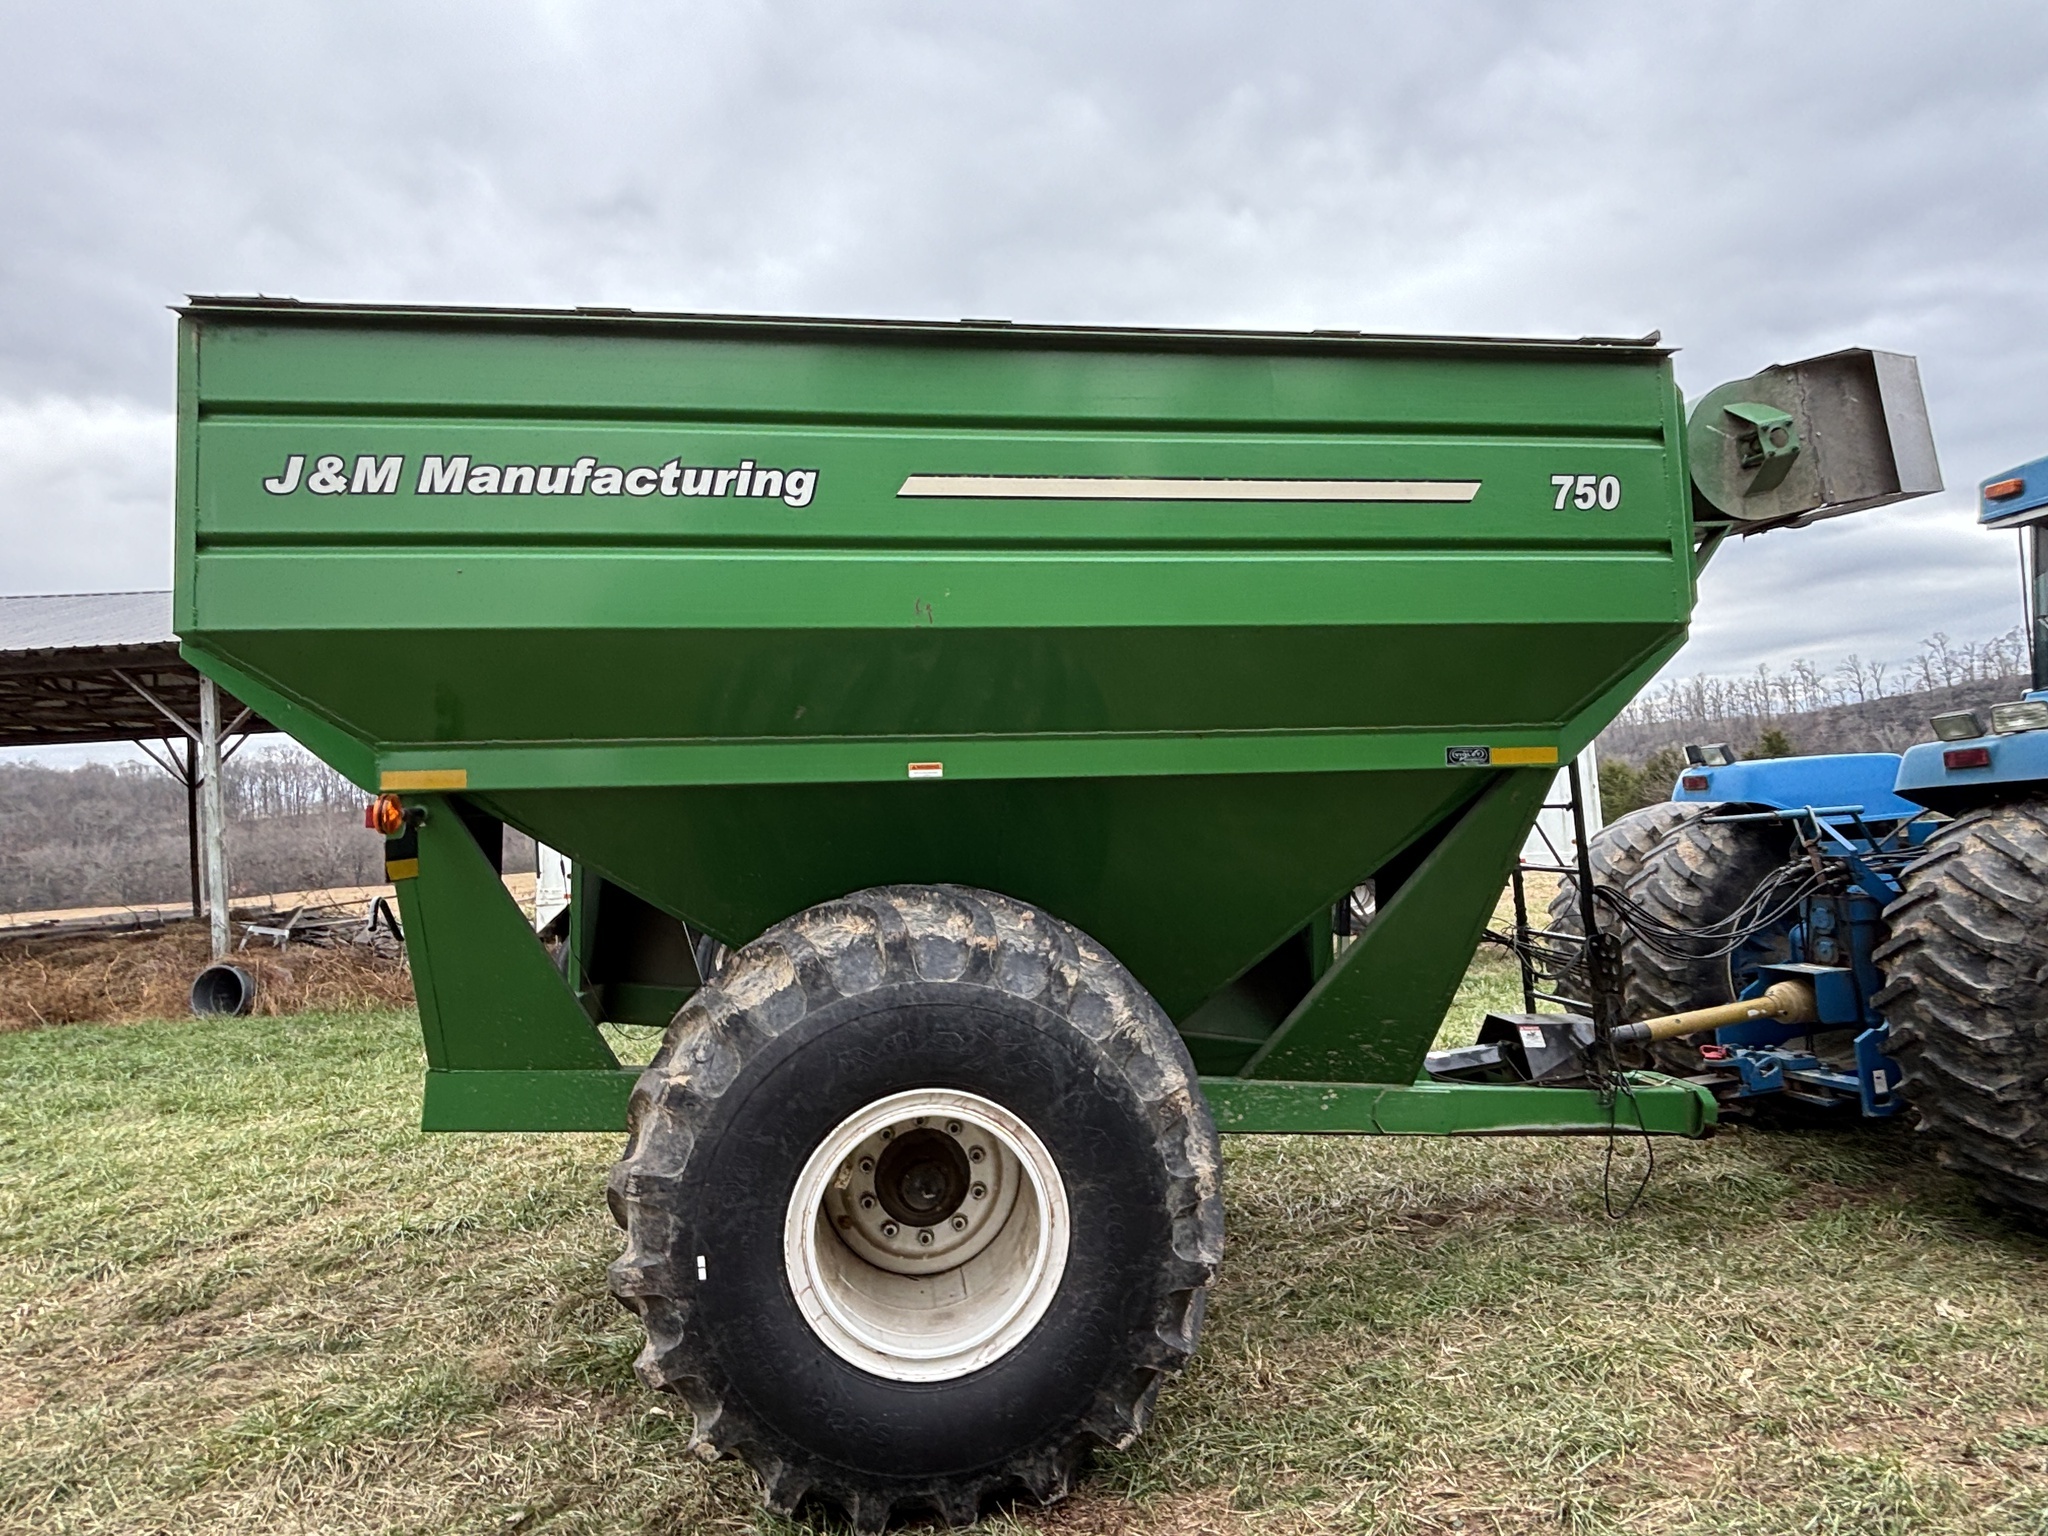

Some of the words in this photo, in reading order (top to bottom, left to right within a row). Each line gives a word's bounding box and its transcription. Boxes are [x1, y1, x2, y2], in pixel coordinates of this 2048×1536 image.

[264, 454, 403, 495] J&M
[416, 455, 819, 508] Manufacturing
[1550, 474, 1622, 511] 750
